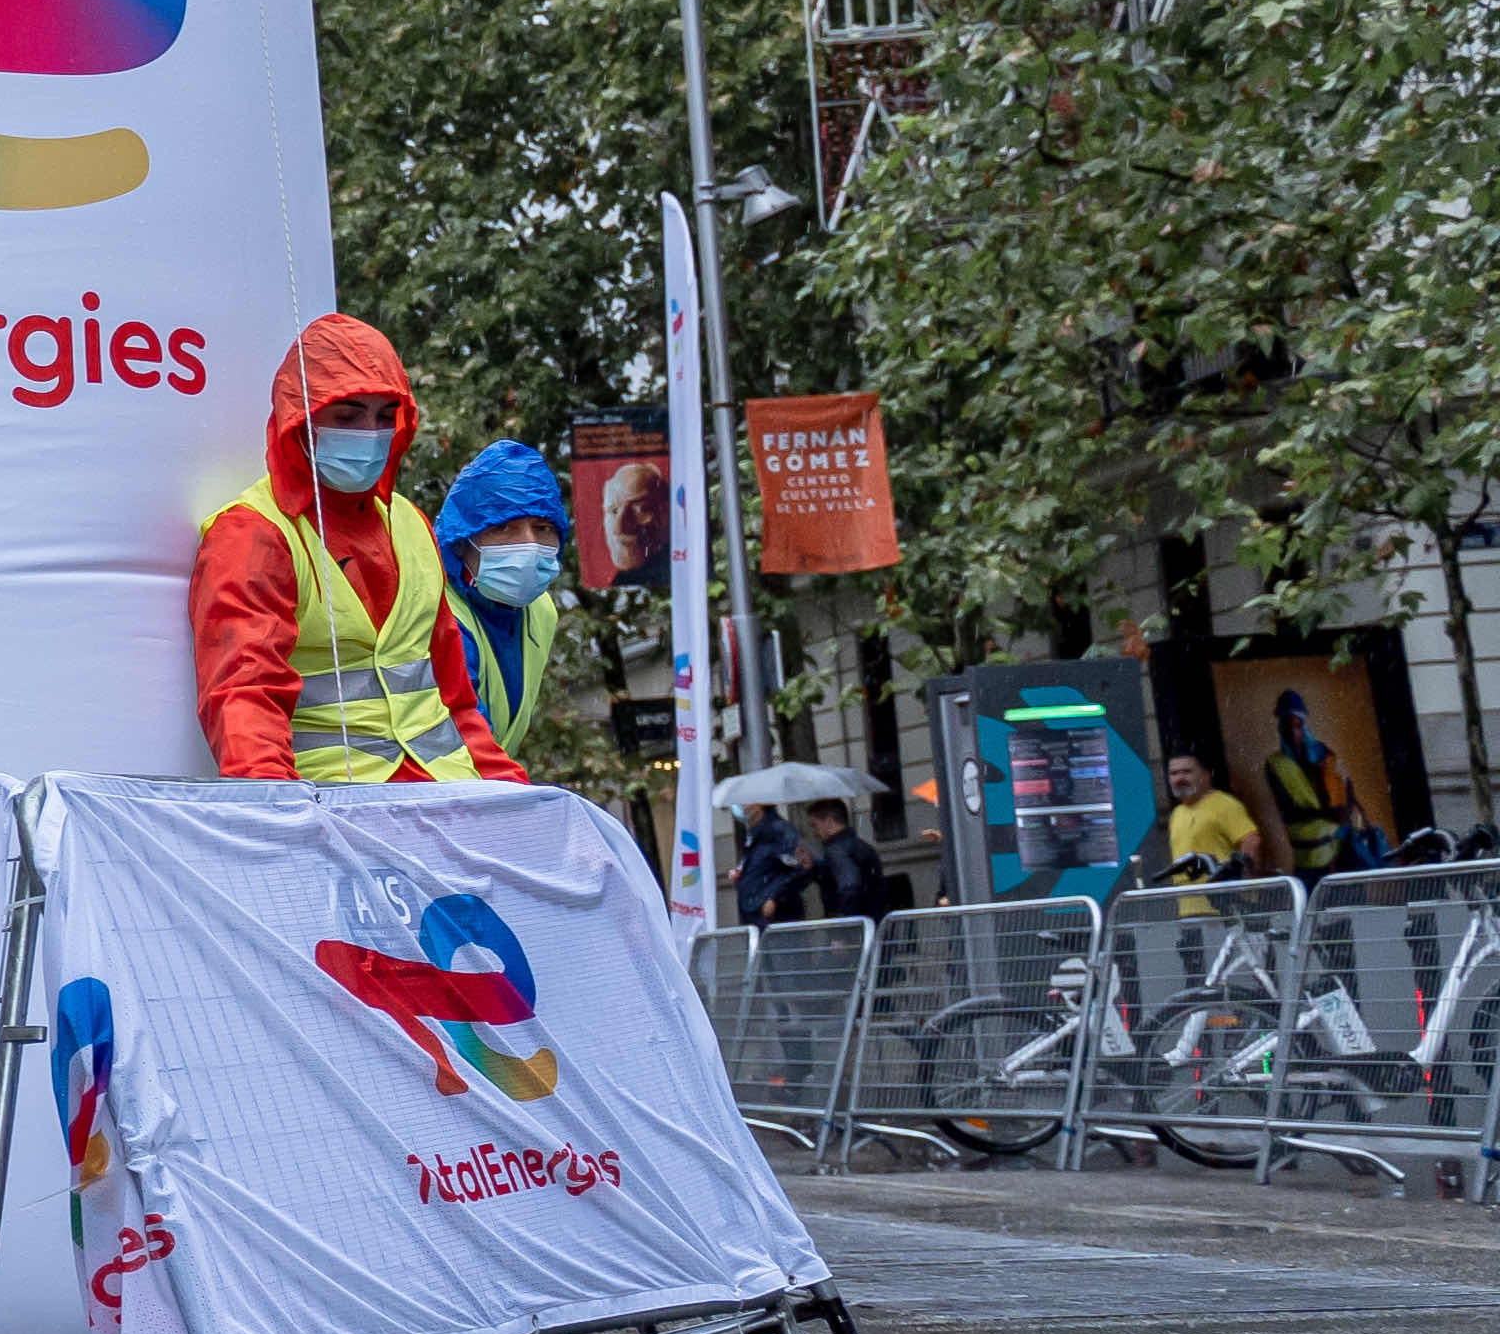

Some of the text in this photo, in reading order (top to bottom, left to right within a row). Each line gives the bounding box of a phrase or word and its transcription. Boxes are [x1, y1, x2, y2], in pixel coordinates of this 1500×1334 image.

[762, 425, 867, 451] FERNÁN
[765, 448, 870, 473] GÓMEZ
[352, 875, 412, 925] AS
